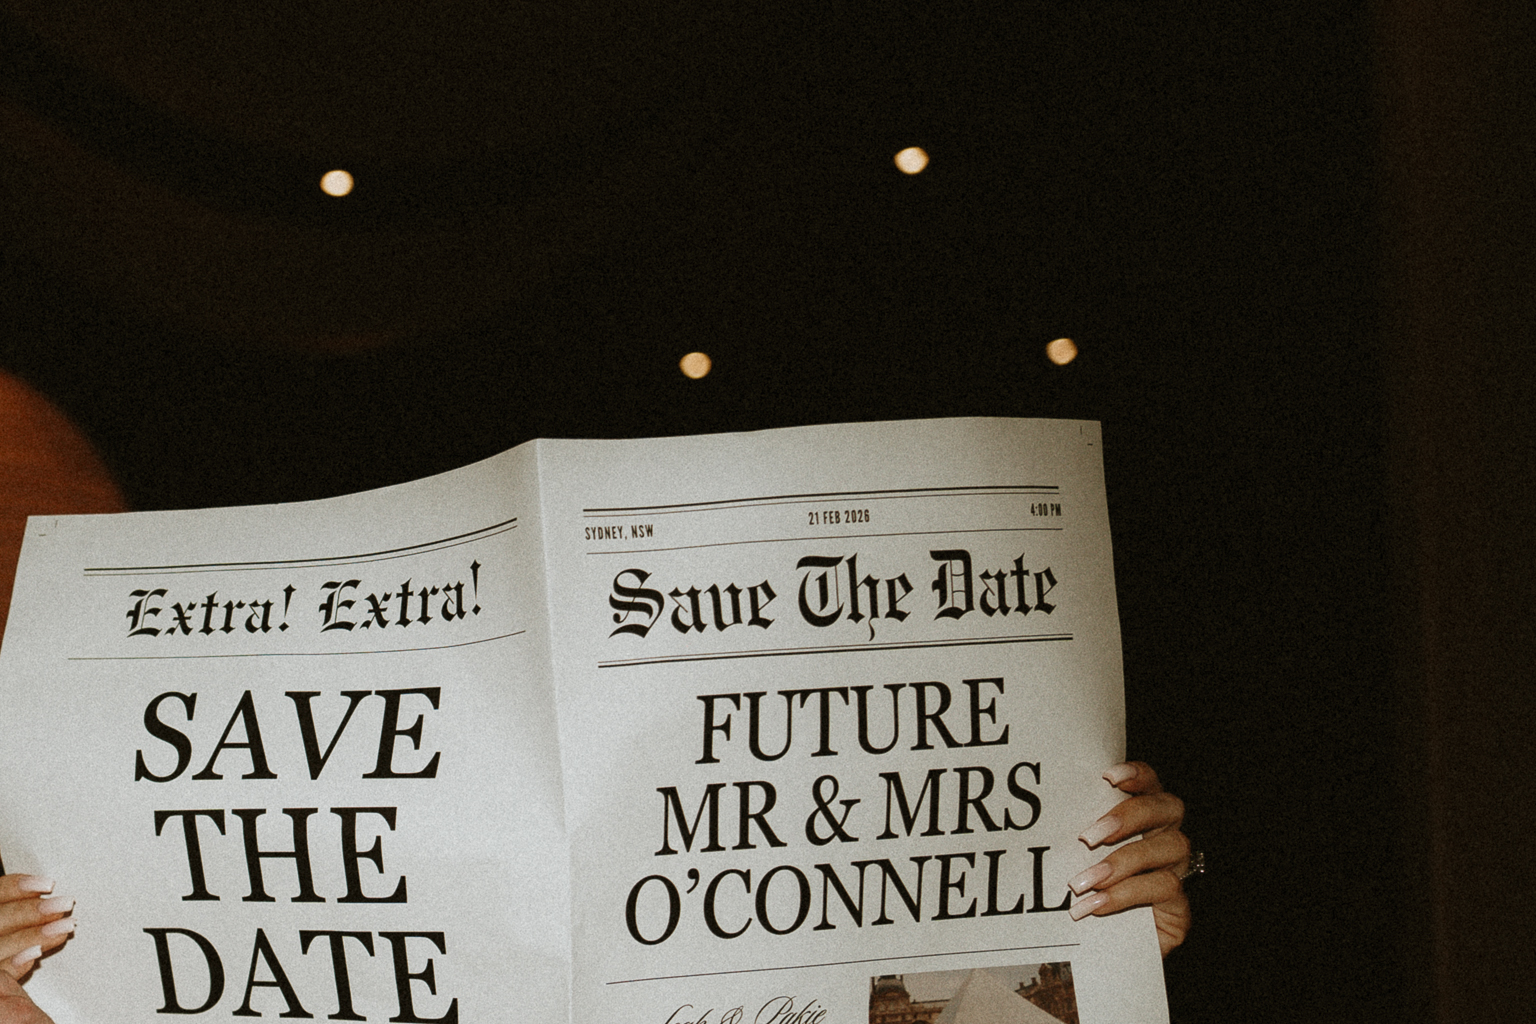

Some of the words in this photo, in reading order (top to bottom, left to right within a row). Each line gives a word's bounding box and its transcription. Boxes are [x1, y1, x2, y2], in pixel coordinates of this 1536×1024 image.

[585, 526, 627, 541] SYDNEY,
[631, 525, 653, 538] NSW
[808, 512, 819, 525] 21
[823, 511, 840, 524] FEB
[844, 509, 870, 523] 2026
[1031, 504, 1048, 516] 4:00
[1049, 503, 1062, 516] PM
[126, 584, 296, 637] Extra!
[317, 560, 481, 632] Extra!
[608, 568, 777, 638] Save
[796, 552, 915, 642] The
[929, 549, 1057, 620] Date
[134, 686, 441, 783] SAVE
[695, 677, 1009, 765] FUTURE
[654, 780, 788, 856] MR
[805, 774, 861, 846] &
[876, 761, 1042, 840] MRS
[153, 806, 408, 904] THE
[625, 846, 1071, 947] O'CONNELL
